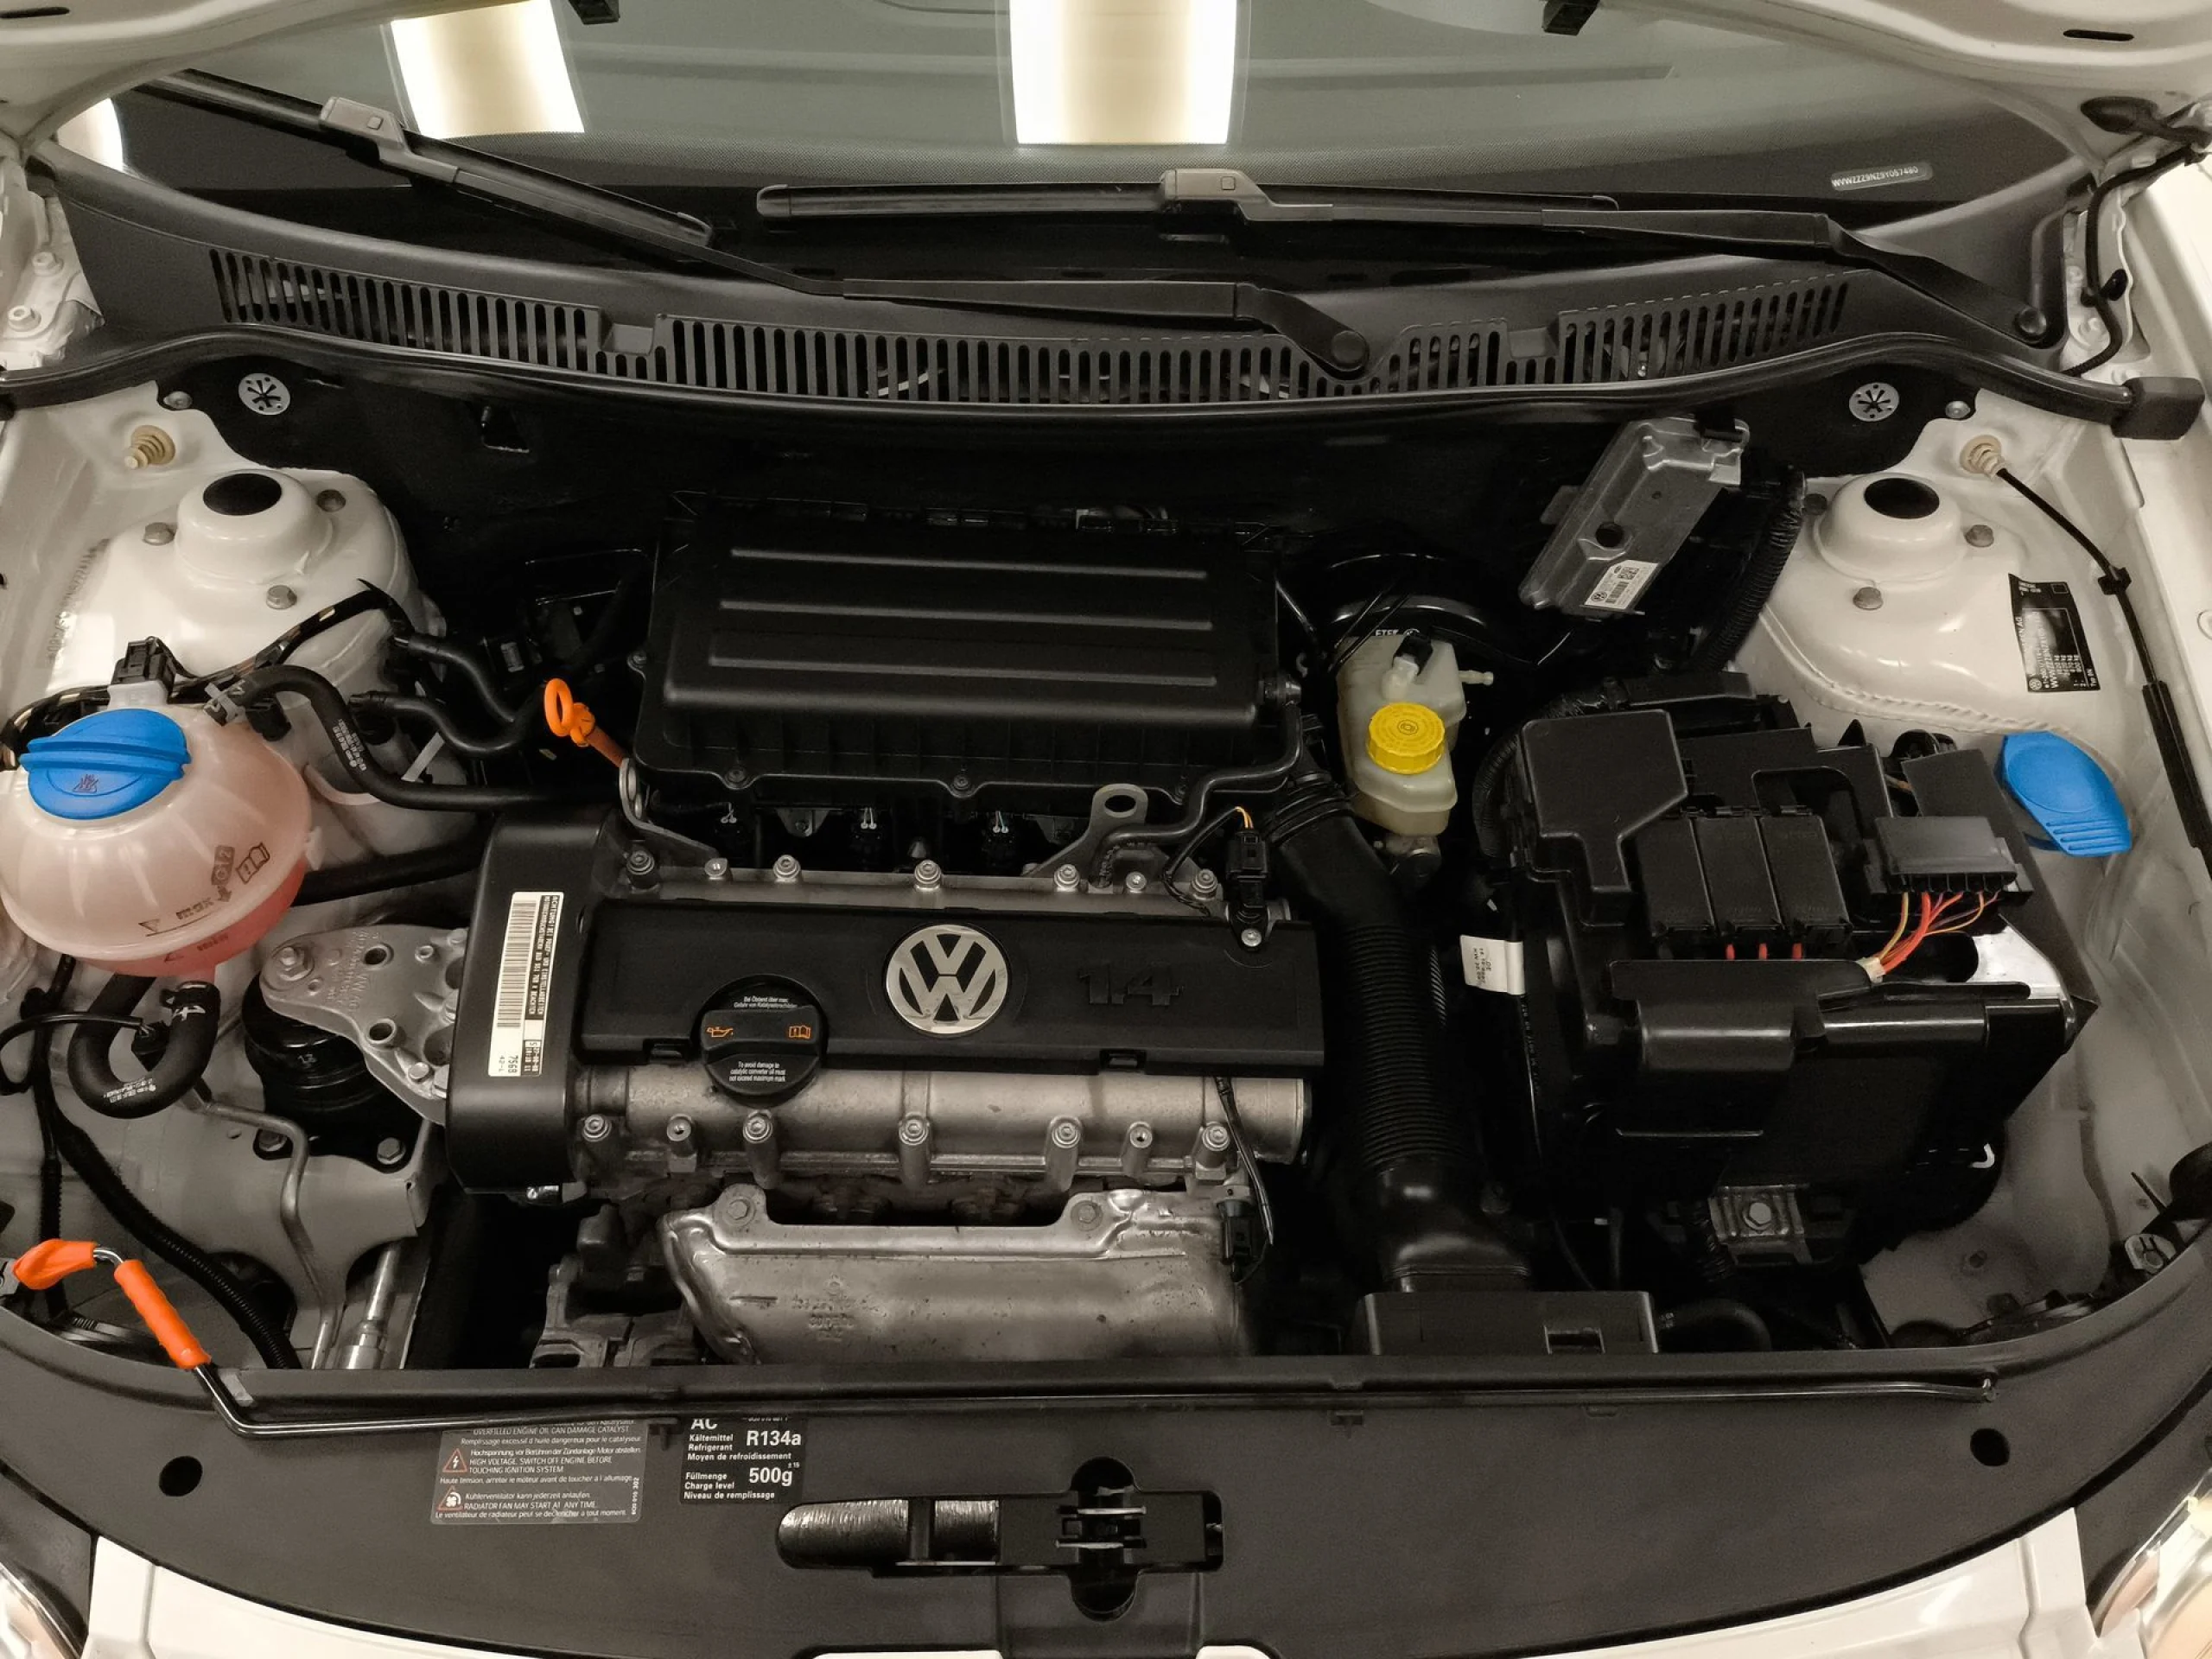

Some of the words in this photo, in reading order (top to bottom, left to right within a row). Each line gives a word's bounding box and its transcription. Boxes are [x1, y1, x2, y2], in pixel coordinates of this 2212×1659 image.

[1078, 959, 1180, 1006] 1.4
[513, 1427, 537, 1435] ENGINE
[567, 1426, 596, 1434] DAMAGE
[461, 1438, 501, 1446] Remplissage
[690, 1433, 734, 1442] Kältemittel
[746, 1430, 802, 1446] R134a
[688, 1444, 733, 1452] Refrigerant
[687, 1452, 715, 1462] Moyen
[718, 1452, 727, 1460] de
[728, 1452, 792, 1460] refroidissement
[469, 1458, 487, 1466] HIGH
[536, 1465, 564, 1473] SYSTEM
[685, 1471, 728, 1481] Füllmenge
[748, 1467, 793, 1487] 500g
[684, 1482, 714, 1491] Charge
[715, 1481, 735, 1490] level
[683, 1491, 712, 1500] Niveau
[726, 1490, 775, 1501] remplissage
[518, 1511, 534, 1520] peut
